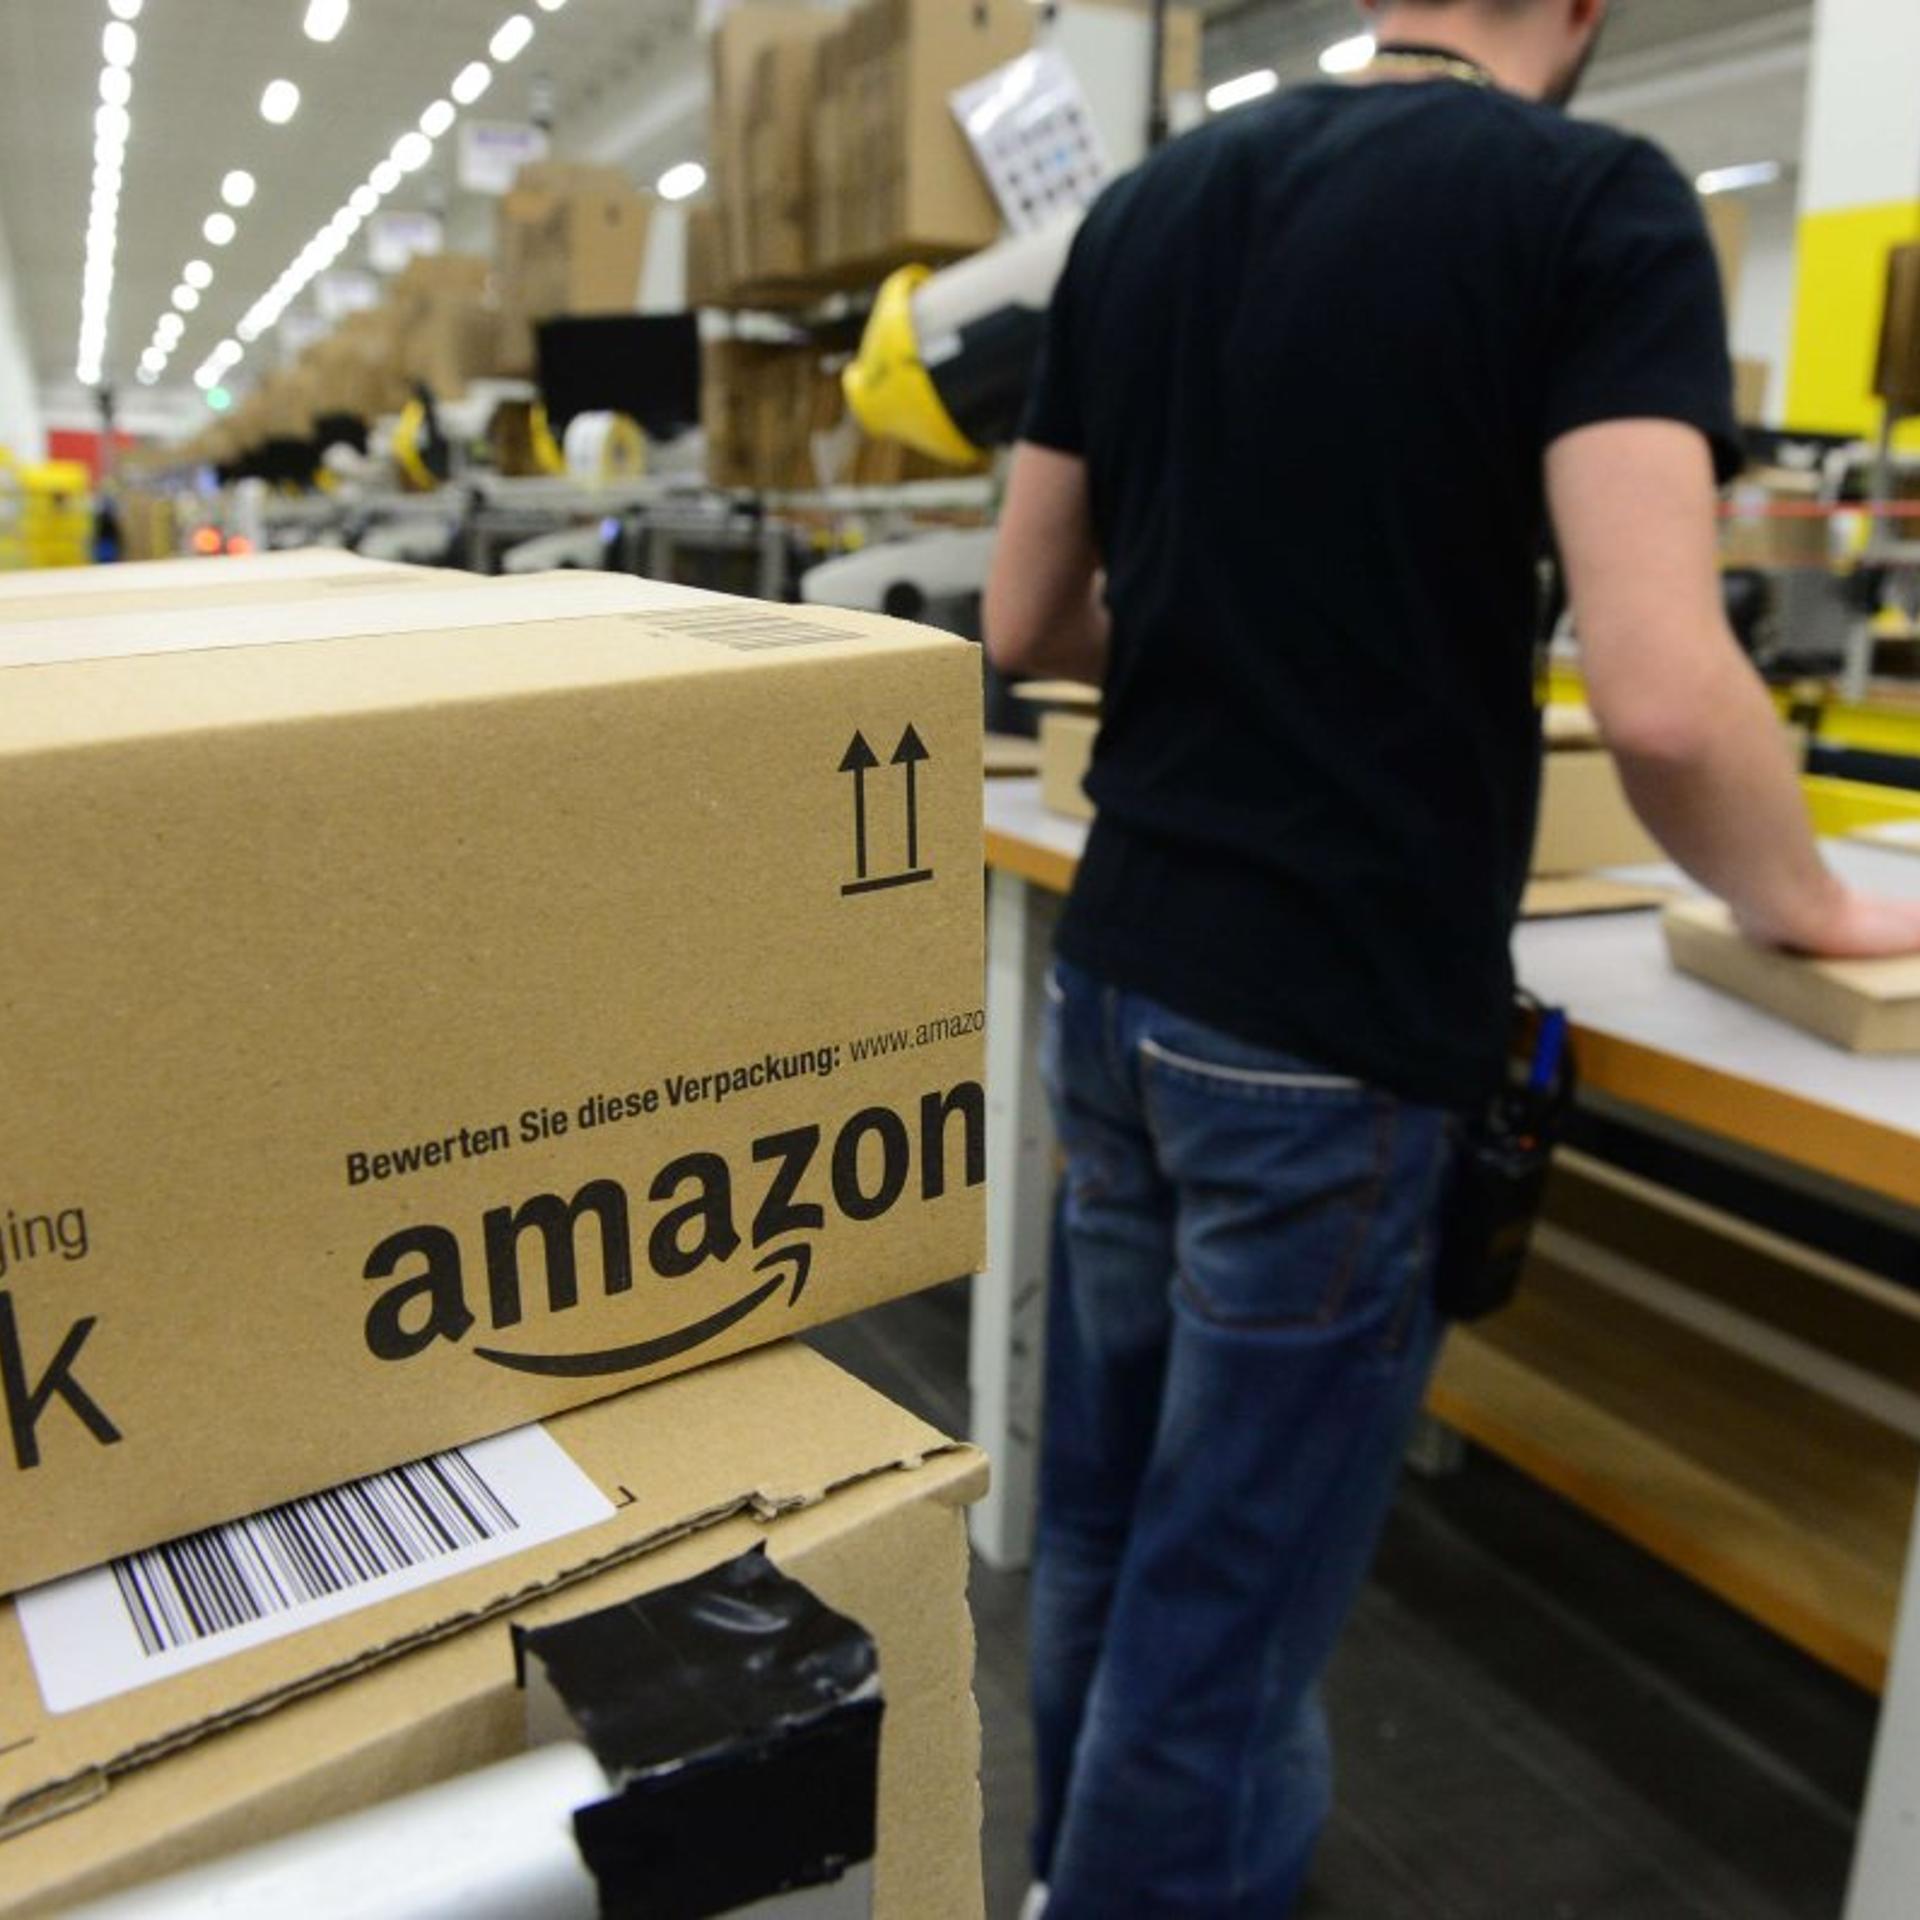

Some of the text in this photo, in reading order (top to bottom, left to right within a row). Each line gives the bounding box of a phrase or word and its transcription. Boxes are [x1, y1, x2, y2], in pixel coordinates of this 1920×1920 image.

[346, 1008, 985, 1186] Bewerten Sie diese Verpackung: www.amazo
[0, 1207, 89, 1278] ing
[363, 1080, 986, 1361] amazon
